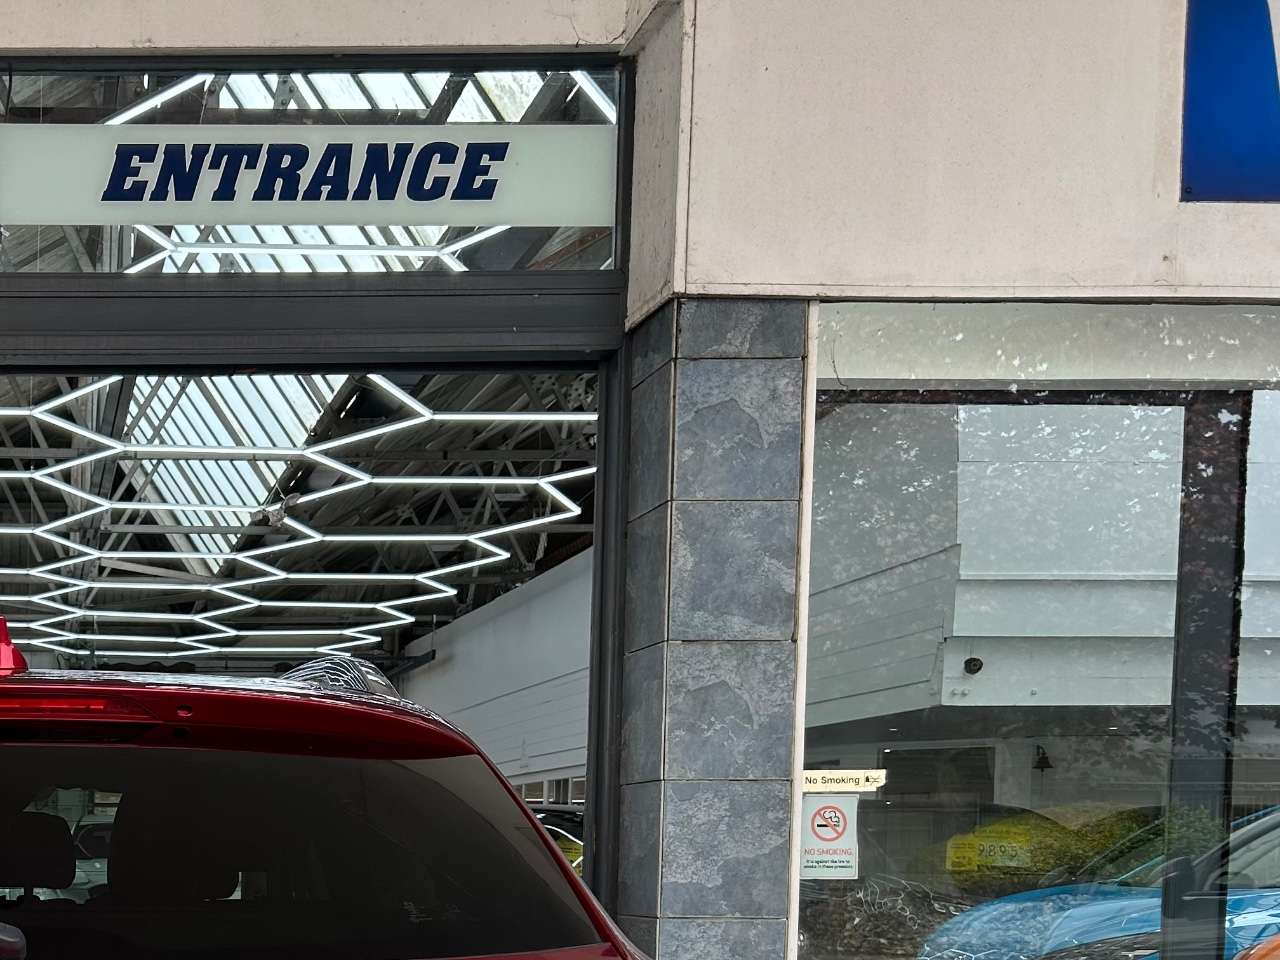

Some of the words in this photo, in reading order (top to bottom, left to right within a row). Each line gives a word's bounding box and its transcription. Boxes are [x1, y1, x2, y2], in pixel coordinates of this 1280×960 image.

[101, 141, 509, 202] ENTRANCE
[805, 776, 818, 784] No
[821, 776, 860, 785] Smoking
[804, 848, 815, 856] NO
[816, 848, 852, 856] SMOKING
